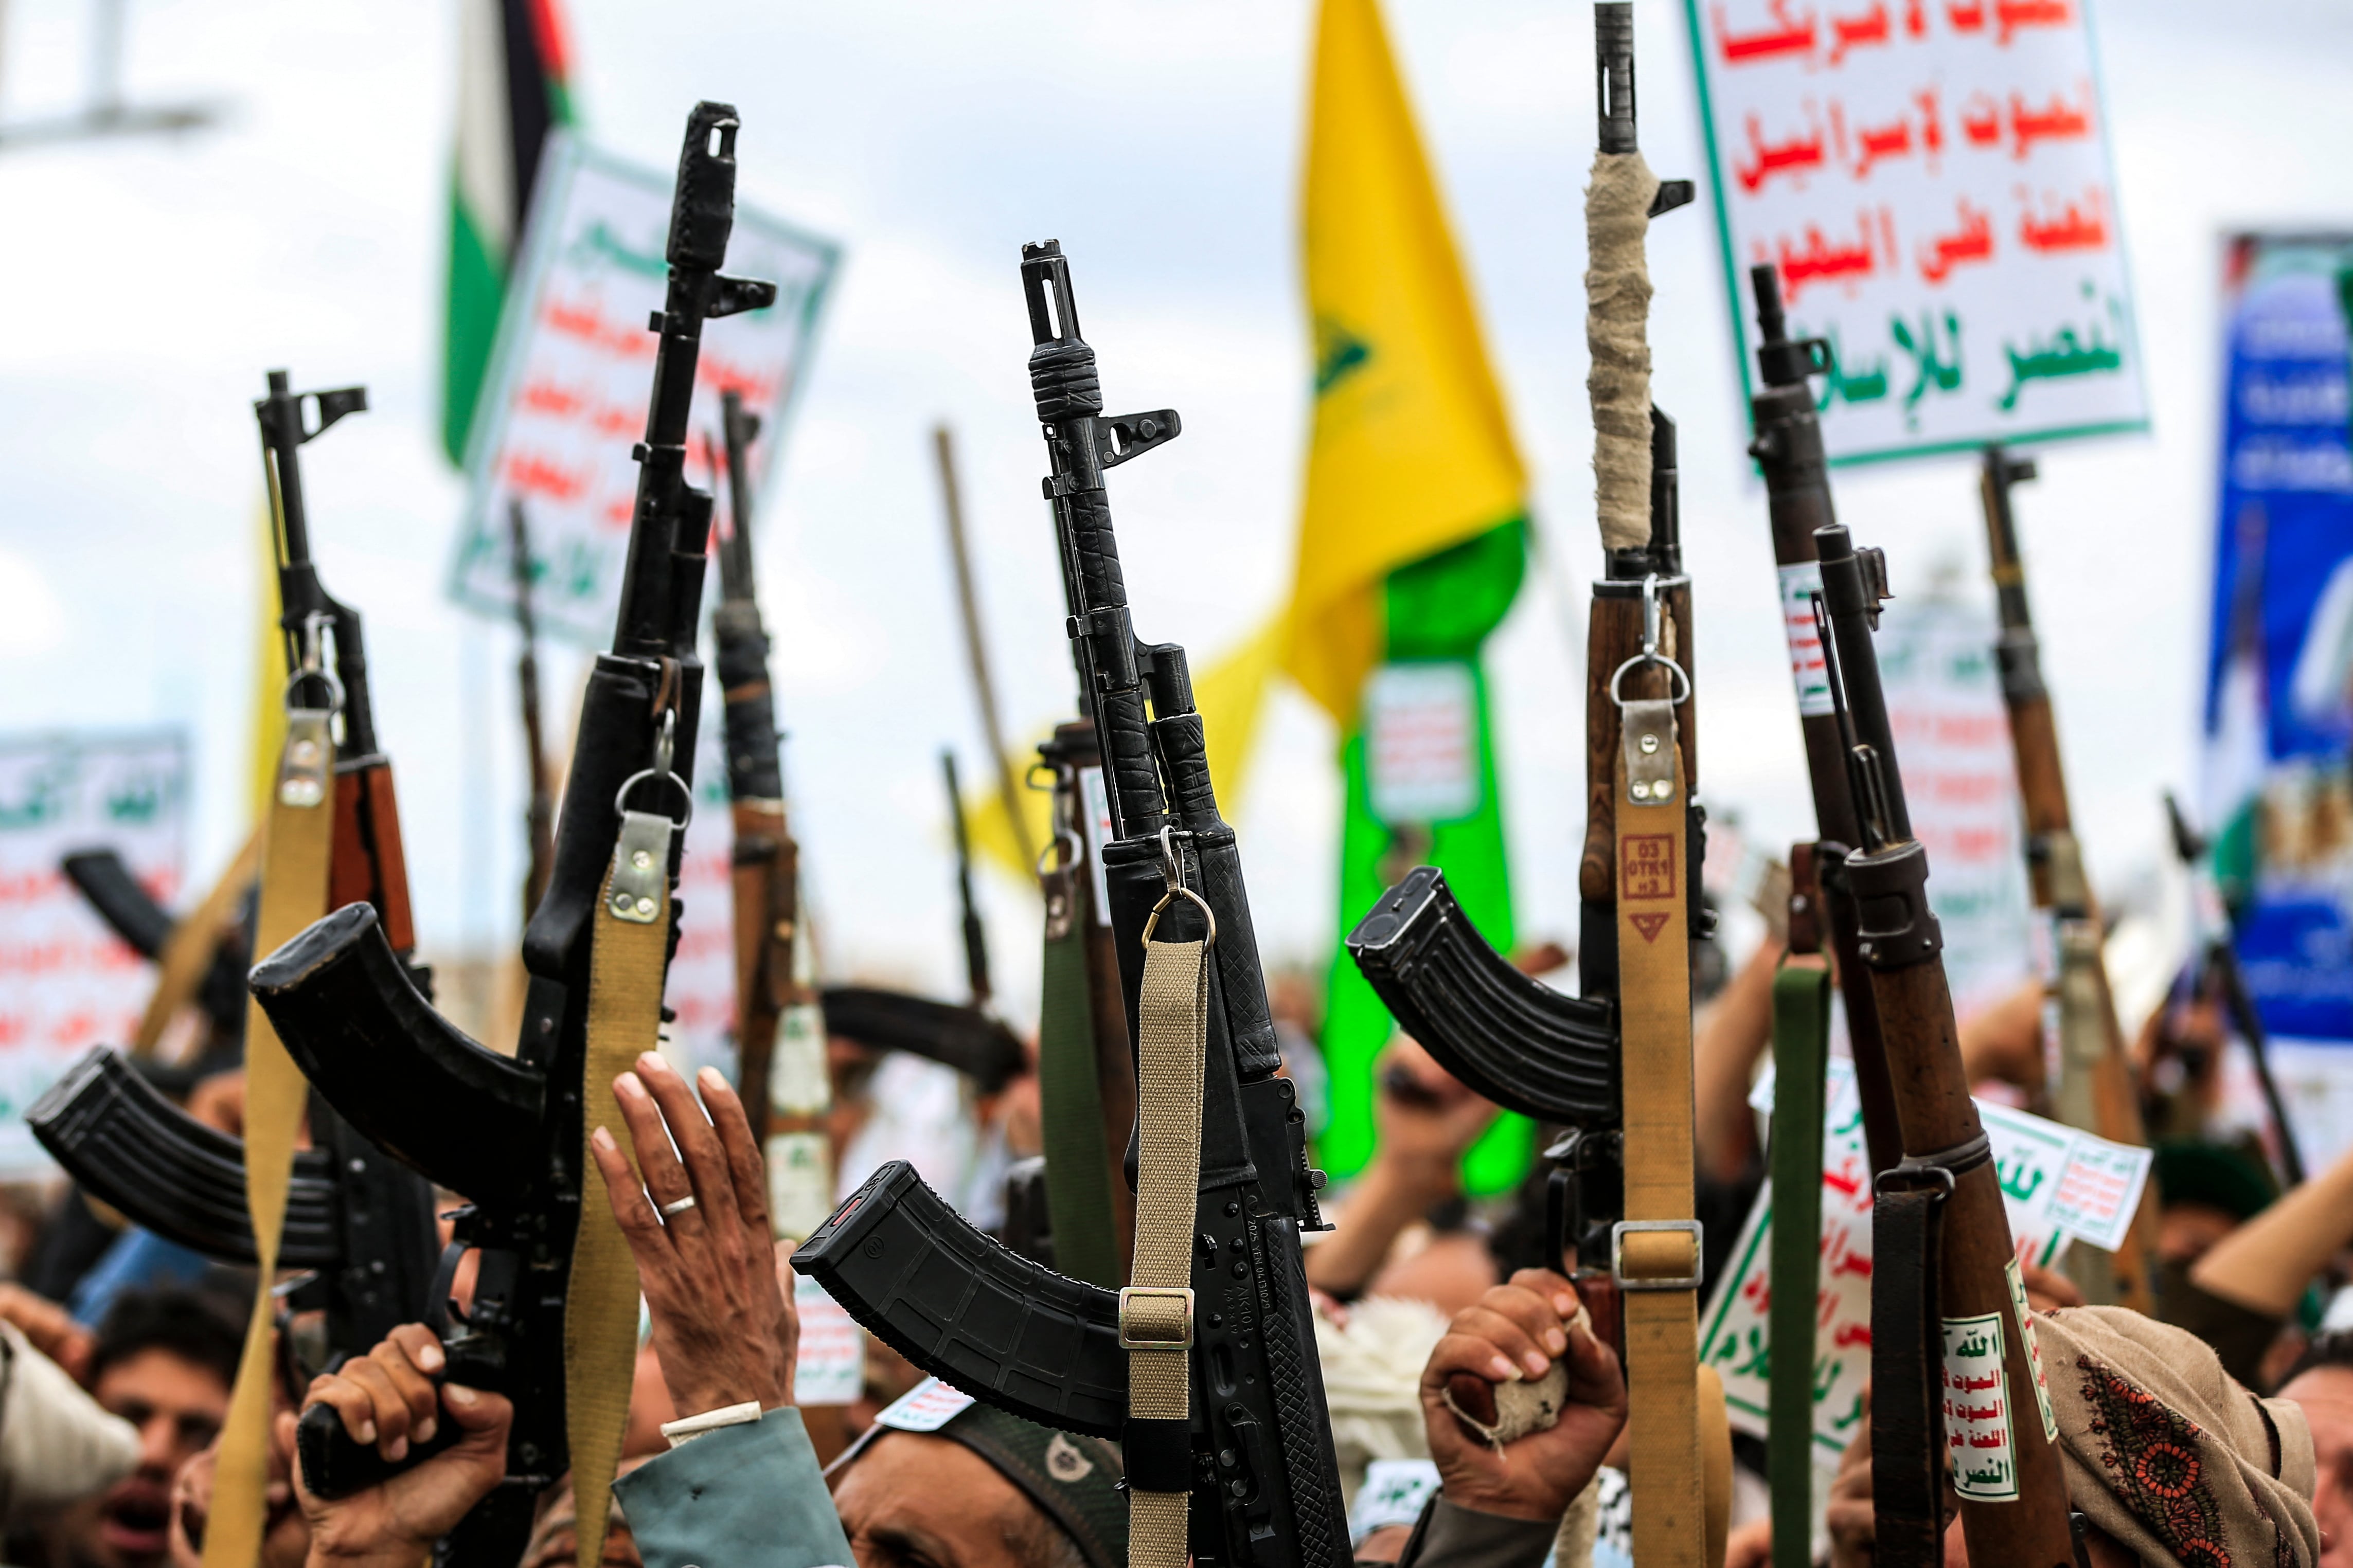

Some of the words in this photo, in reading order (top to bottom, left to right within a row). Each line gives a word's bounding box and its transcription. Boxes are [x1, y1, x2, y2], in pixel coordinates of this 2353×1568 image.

[1248, 1220, 1259, 1242] 2025
[1252, 1245, 1263, 1265] YEN
[1956, 1328, 1998, 1358] الله
[1952, 1368, 2002, 1394] الموت
[1955, 1398, 2004, 1423] الموت
[1969, 1428, 2007, 1448] اللعنة
[1963, 1457, 2010, 1488] النصر
